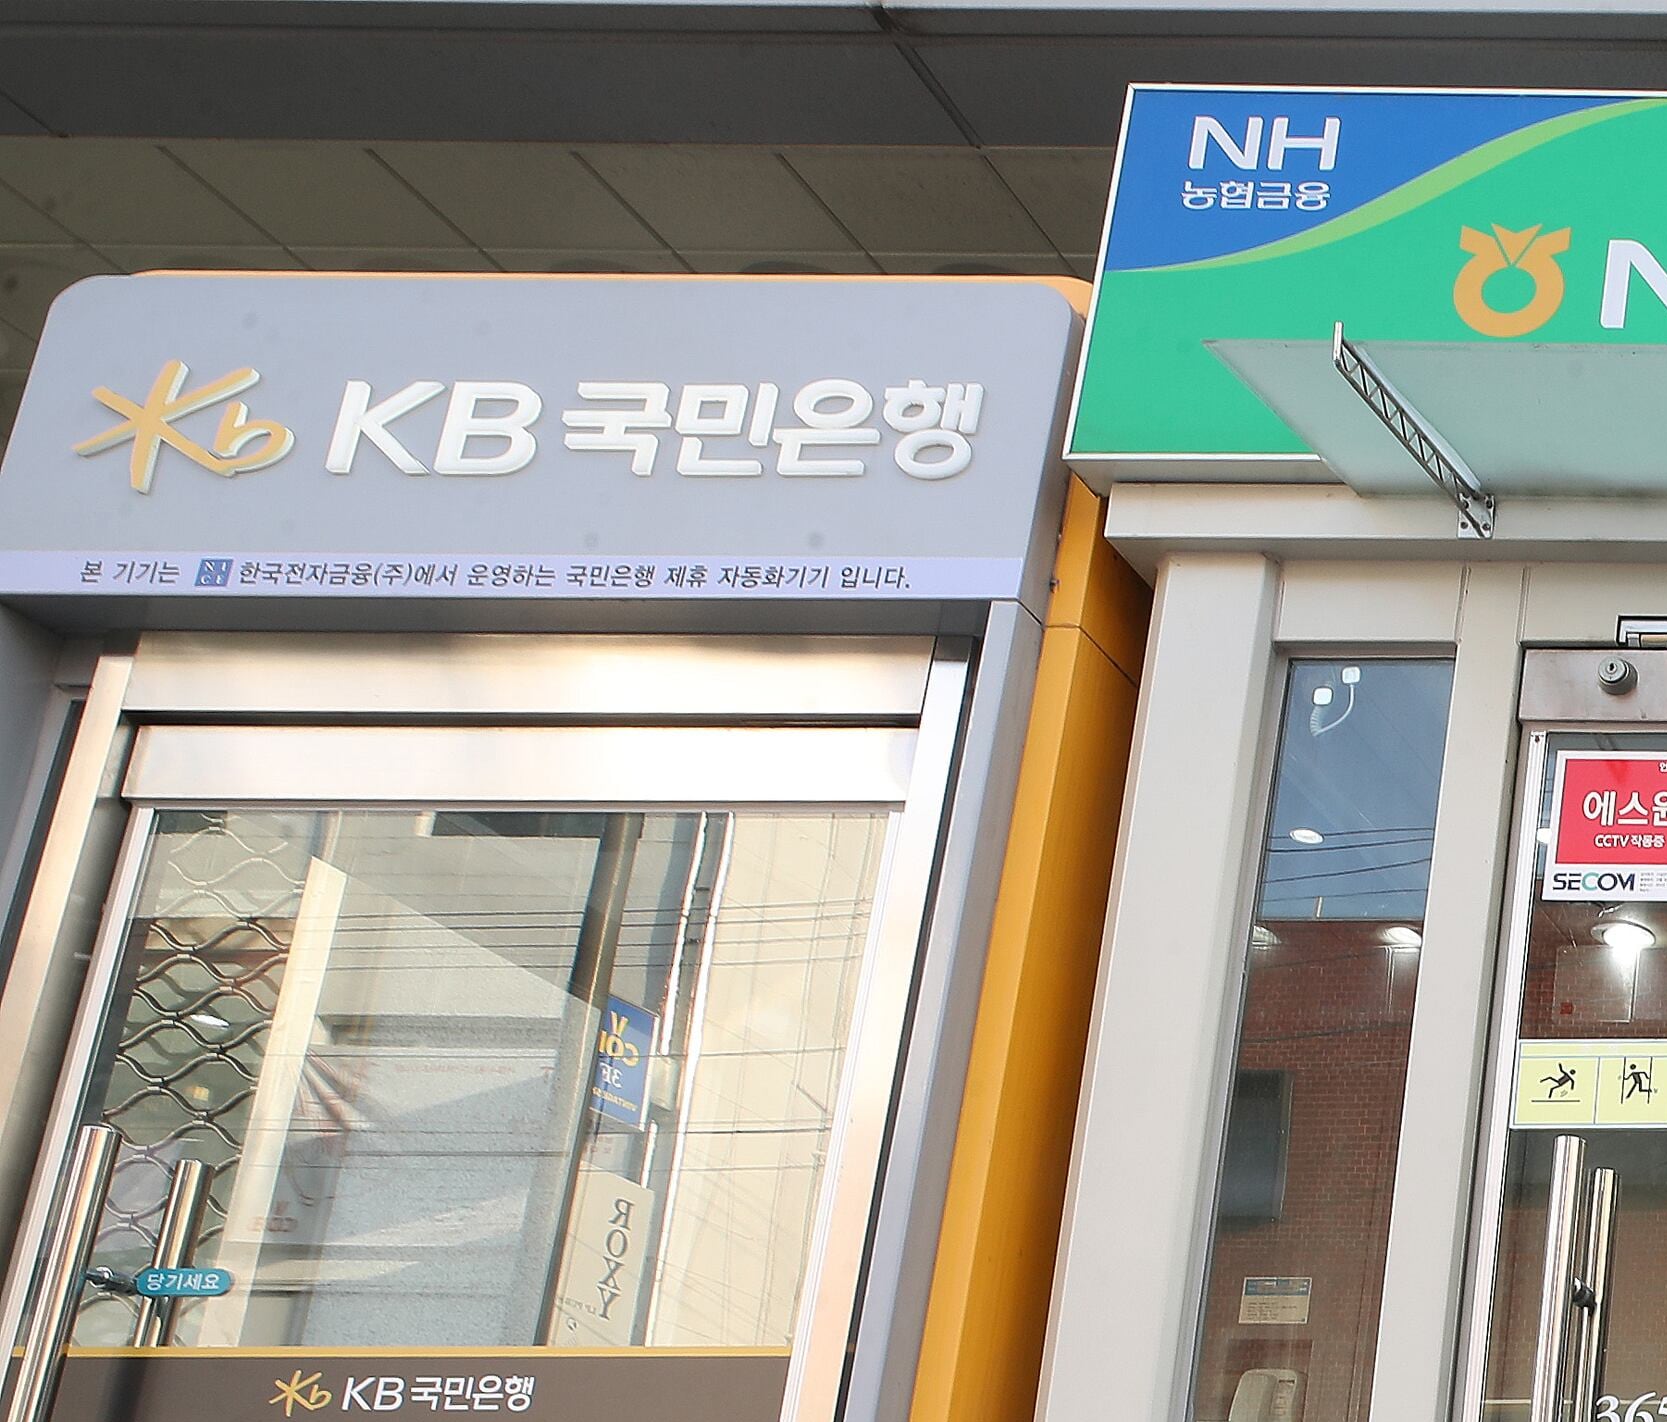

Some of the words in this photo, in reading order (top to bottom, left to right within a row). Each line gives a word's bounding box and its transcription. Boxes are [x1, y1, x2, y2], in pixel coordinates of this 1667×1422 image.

[1188, 114, 1340, 172] NH
[1179, 178, 1332, 212] 농협금융
[80, 560, 102, 584] 본
[112, 561, 180, 584] 기기는
[239, 561, 457, 586] 한국전자금융(주)에서
[466, 564, 556, 588] 운영하는
[566, 565, 655, 589] 국민은행
[664, 565, 708, 589] 제휴
[717, 565, 830, 589] 자동화기기
[840, 566, 911, 589] 입니다.
[1594, 834, 1629, 848] CCTV
[1630, 834, 1665, 848] 작동중
[1553, 872, 1635, 891] SECOM
[146, 1272, 220, 1292] 당기세요
